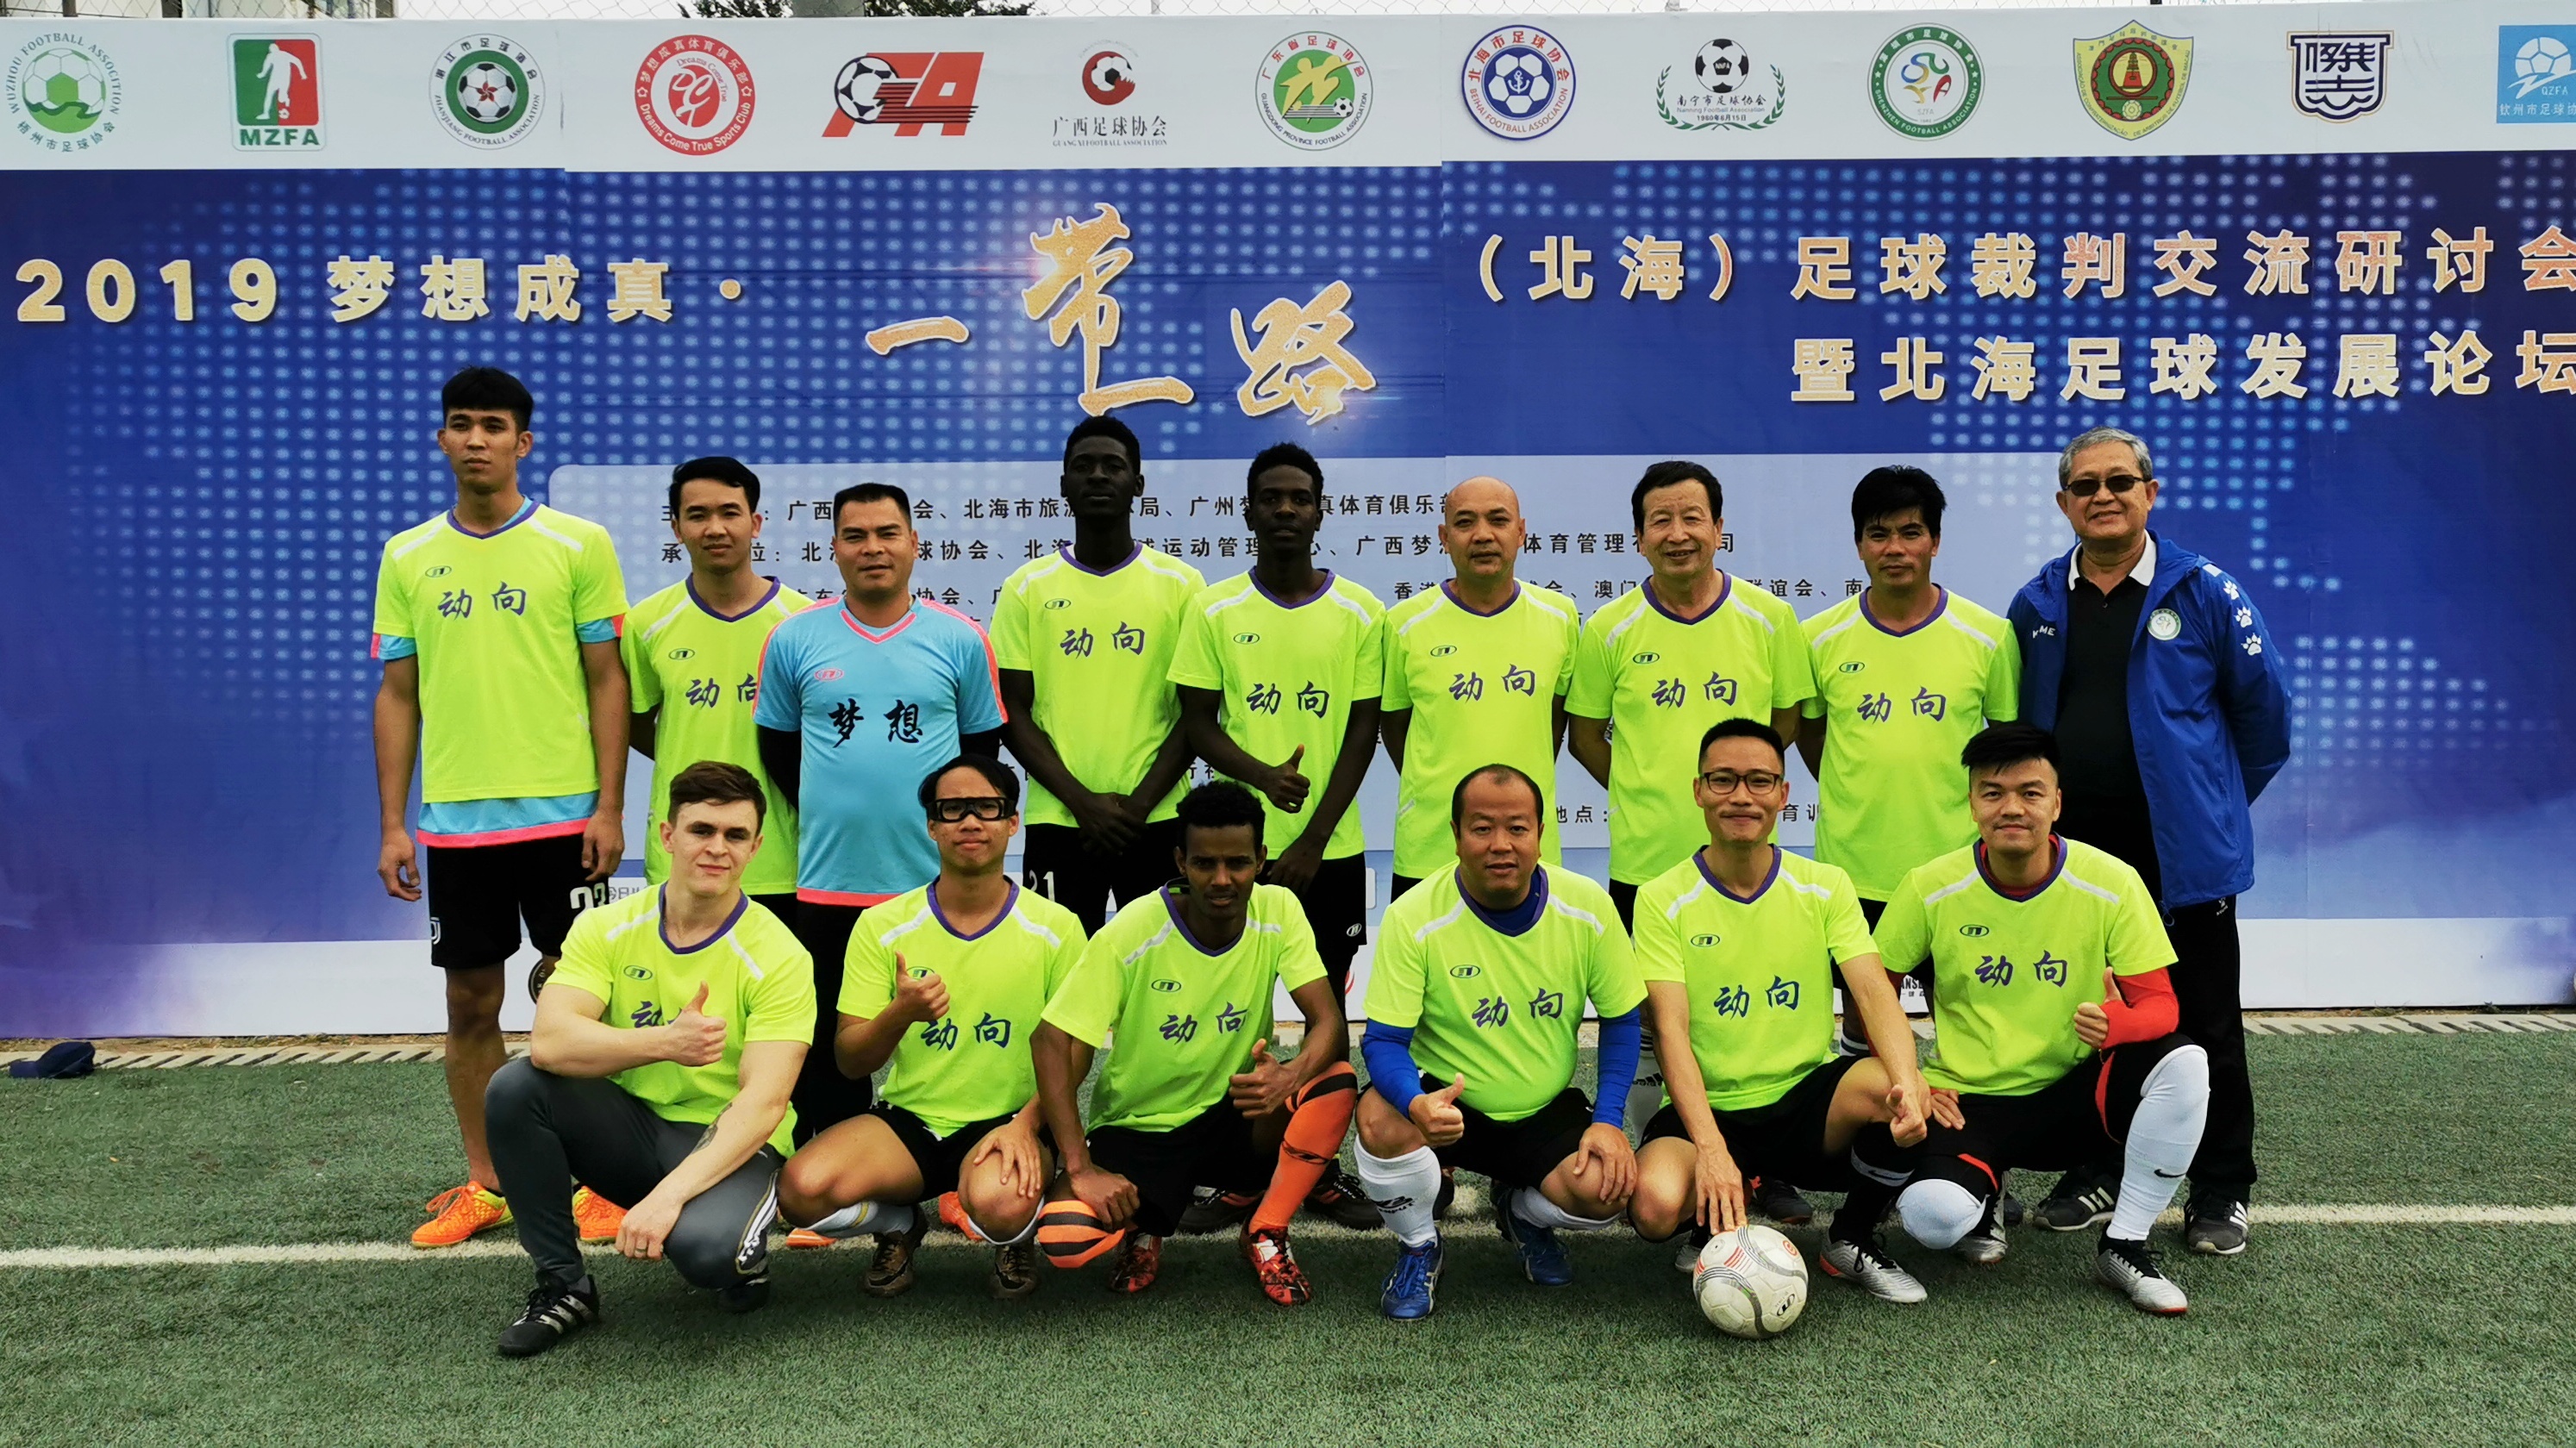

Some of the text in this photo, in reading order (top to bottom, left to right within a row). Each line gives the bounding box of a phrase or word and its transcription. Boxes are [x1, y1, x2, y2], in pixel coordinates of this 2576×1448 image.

[6, 56, 22, 114] WUZHOU
[21, 33, 84, 56] FOOTBALL
[640, 37, 749, 84] 梦想成真体育俱乐部
[676, 57, 707, 67] Dreams
[1467, 30, 1570, 83] 北海市足球协会
[1469, 87, 1568, 133] BEIHAI FOOTBALL ASSOCIATION
[1677, 94, 1766, 107] 南宁市足球协会
[1875, 88, 1978, 134] SHENZHEN FOOTBALL ASSOCIATION
[2542, 85, 2568, 97] QZFA
[240, 129, 320, 147] MZFA
[463, 133, 507, 145] FOOTBALL
[509, 94, 541, 140] ASSOCIATION
[640, 102, 751, 152] Dreams Come True Sports Club
[1053, 115, 1167, 137] 广西足球协会
[1260, 92, 1368, 146] GUANGDONG PROVINCE FOOTBALL ASSOCIATION
[15, 258, 278, 322] 2019
[1791, 226, 2576, 301] 足球裁判交流研讨会
[1791, 329, 2576, 403] 暨北海足球发展论坛
[437, 581, 527, 621] 动向
[1060, 621, 1145, 658] 动向
[1246, 680, 1330, 719] 动向
[1448, 664, 1536, 703] 动向
[1651, 671, 1738, 710] 动向
[1857, 685, 1947, 724] 动向
[827, 697, 923, 748] 梦想
[1975, 950, 2068, 988] 动向
[1472, 987, 1563, 1029] 动向
[1713, 975, 1799, 1020] 动向
[921, 1012, 1011, 1052] 动向
[1159, 1002, 1248, 1044] 动向
